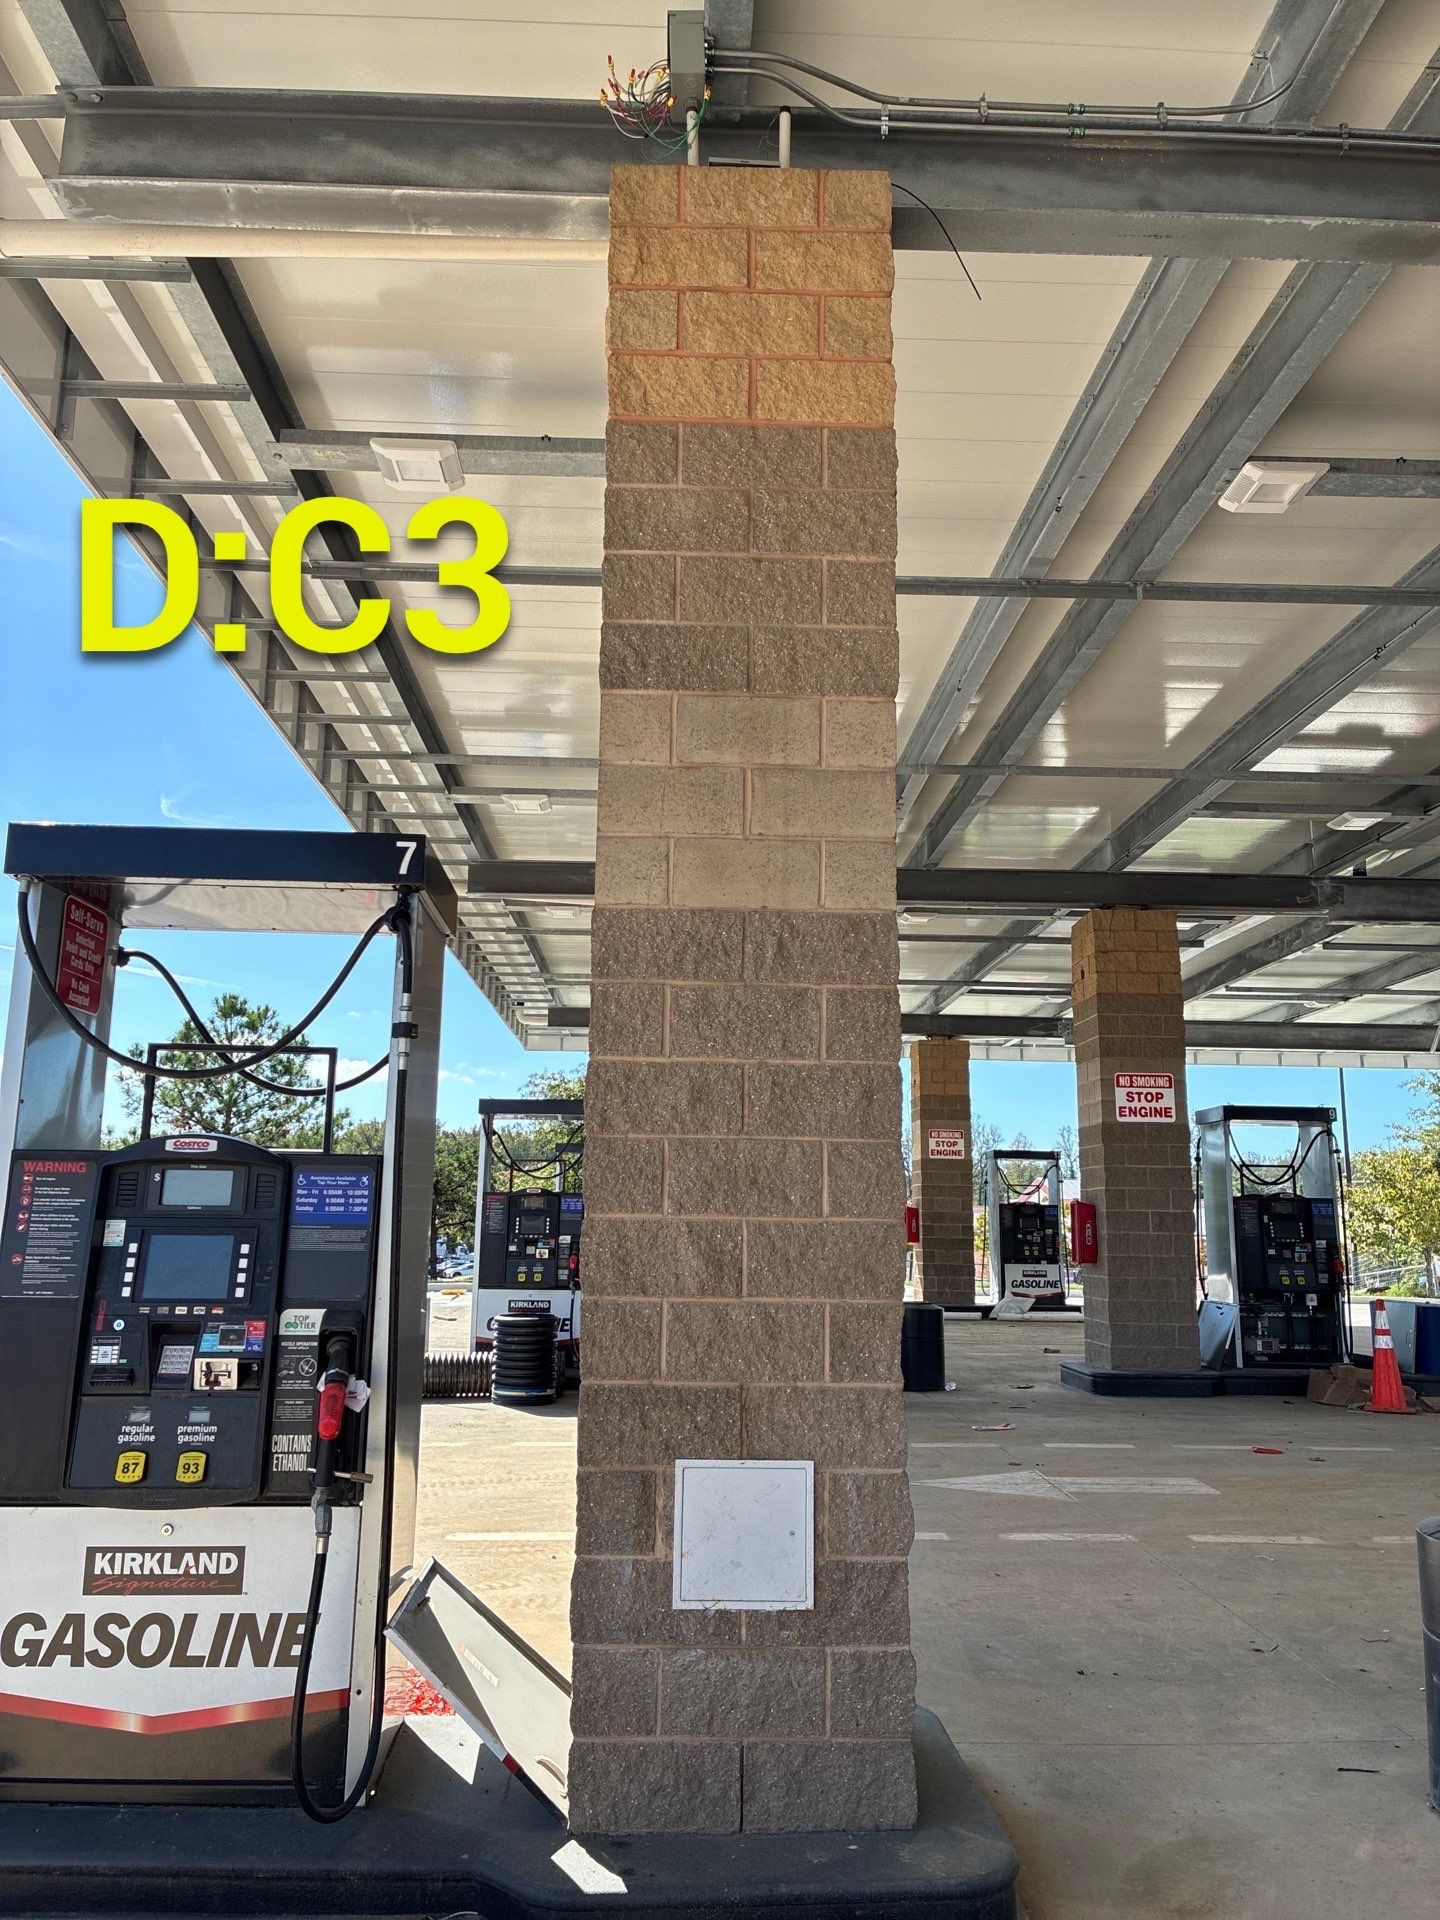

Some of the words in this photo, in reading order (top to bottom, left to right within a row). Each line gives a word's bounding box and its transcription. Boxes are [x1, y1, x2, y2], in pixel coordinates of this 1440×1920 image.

[395, 841, 418, 875] 7
[70, 904, 104, 933] Self-Serve
[1119, 1076, 1131, 1087] NO
[1132, 1076, 1170, 1087] SMOKING
[1125, 1091, 1164, 1103] STOP
[1118, 1106, 1173, 1118] ENGINE
[1328, 1108, 1336, 1120] 9
[173, 1140, 210, 1148] COSTCO
[935, 1140, 958, 1148] STOP
[930, 1149, 963, 1157] ENGINE
[24, 1161, 87, 1173] WARNING
[154, 1173, 161, 1182] $
[1011, 1279, 1061, 1288] GASOLINE
[122, 1424, 154, 1435] regular
[177, 1424, 218, 1434] premium
[118, 1433, 156, 1444] gasoline
[177, 1433, 215, 1444] gasoline
[272, 1434, 312, 1453] CONTAINS
[122, 1462, 140, 1474] 87
[182, 1463, 199, 1474] 93
[272, 1454, 308, 1471] ETHANOL
[93, 1552, 239, 1576] KIRKLAND
[92, 1574, 238, 1597] Signature
[0, 1611, 323, 1669] GASOLINE
